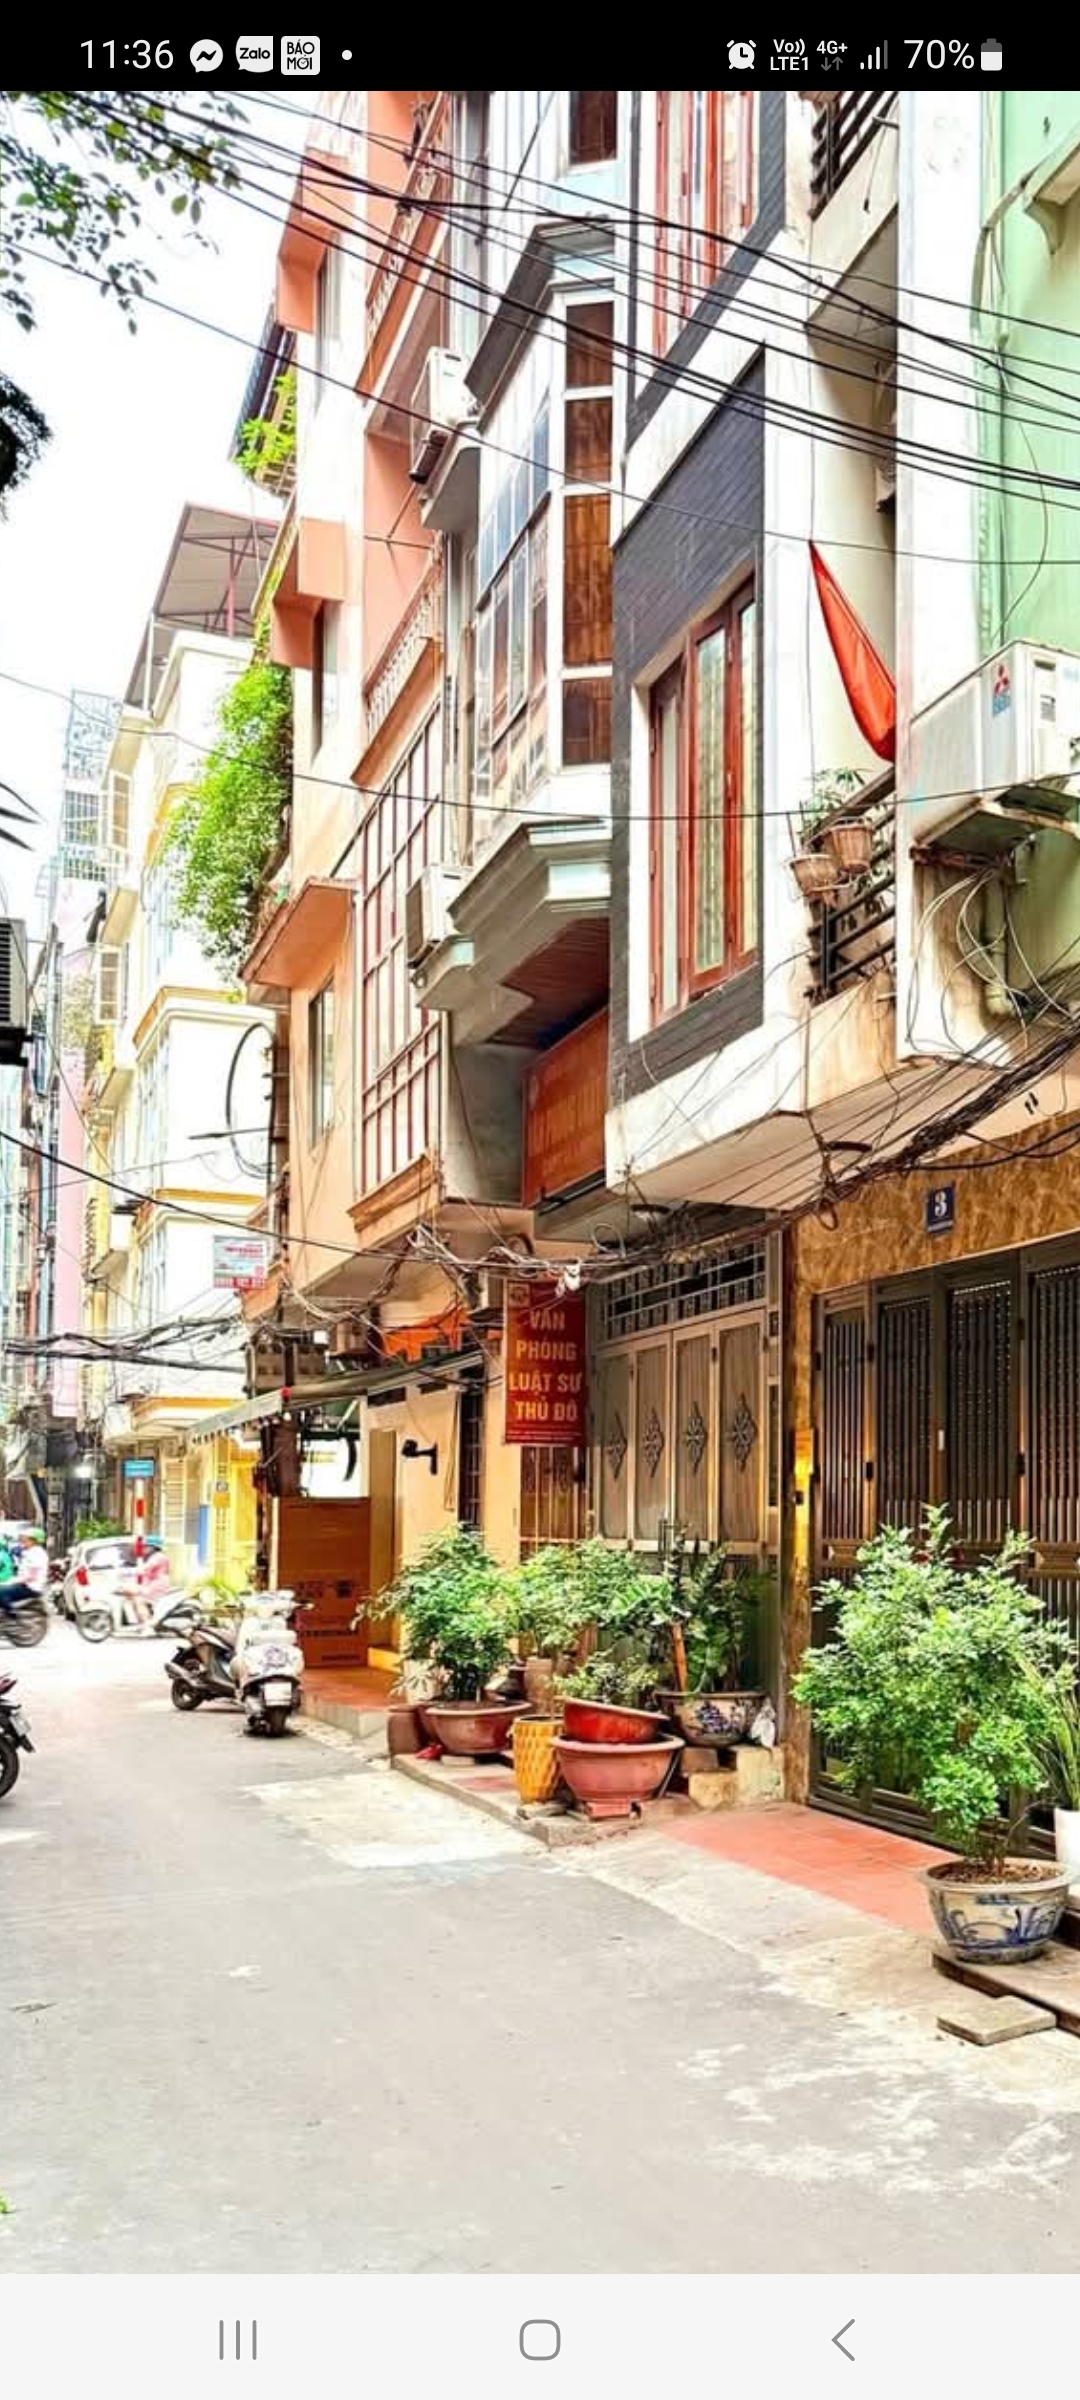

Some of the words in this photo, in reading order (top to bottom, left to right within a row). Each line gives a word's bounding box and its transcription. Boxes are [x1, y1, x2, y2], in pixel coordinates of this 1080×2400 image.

[934, 1191, 948, 1217] 3
[529, 1308, 565, 1330] VĂN
[508, 1371, 552, 1396] LUẬT
[557, 1371, 583, 1393] SƯ
[514, 1397, 549, 1421] THỦ
